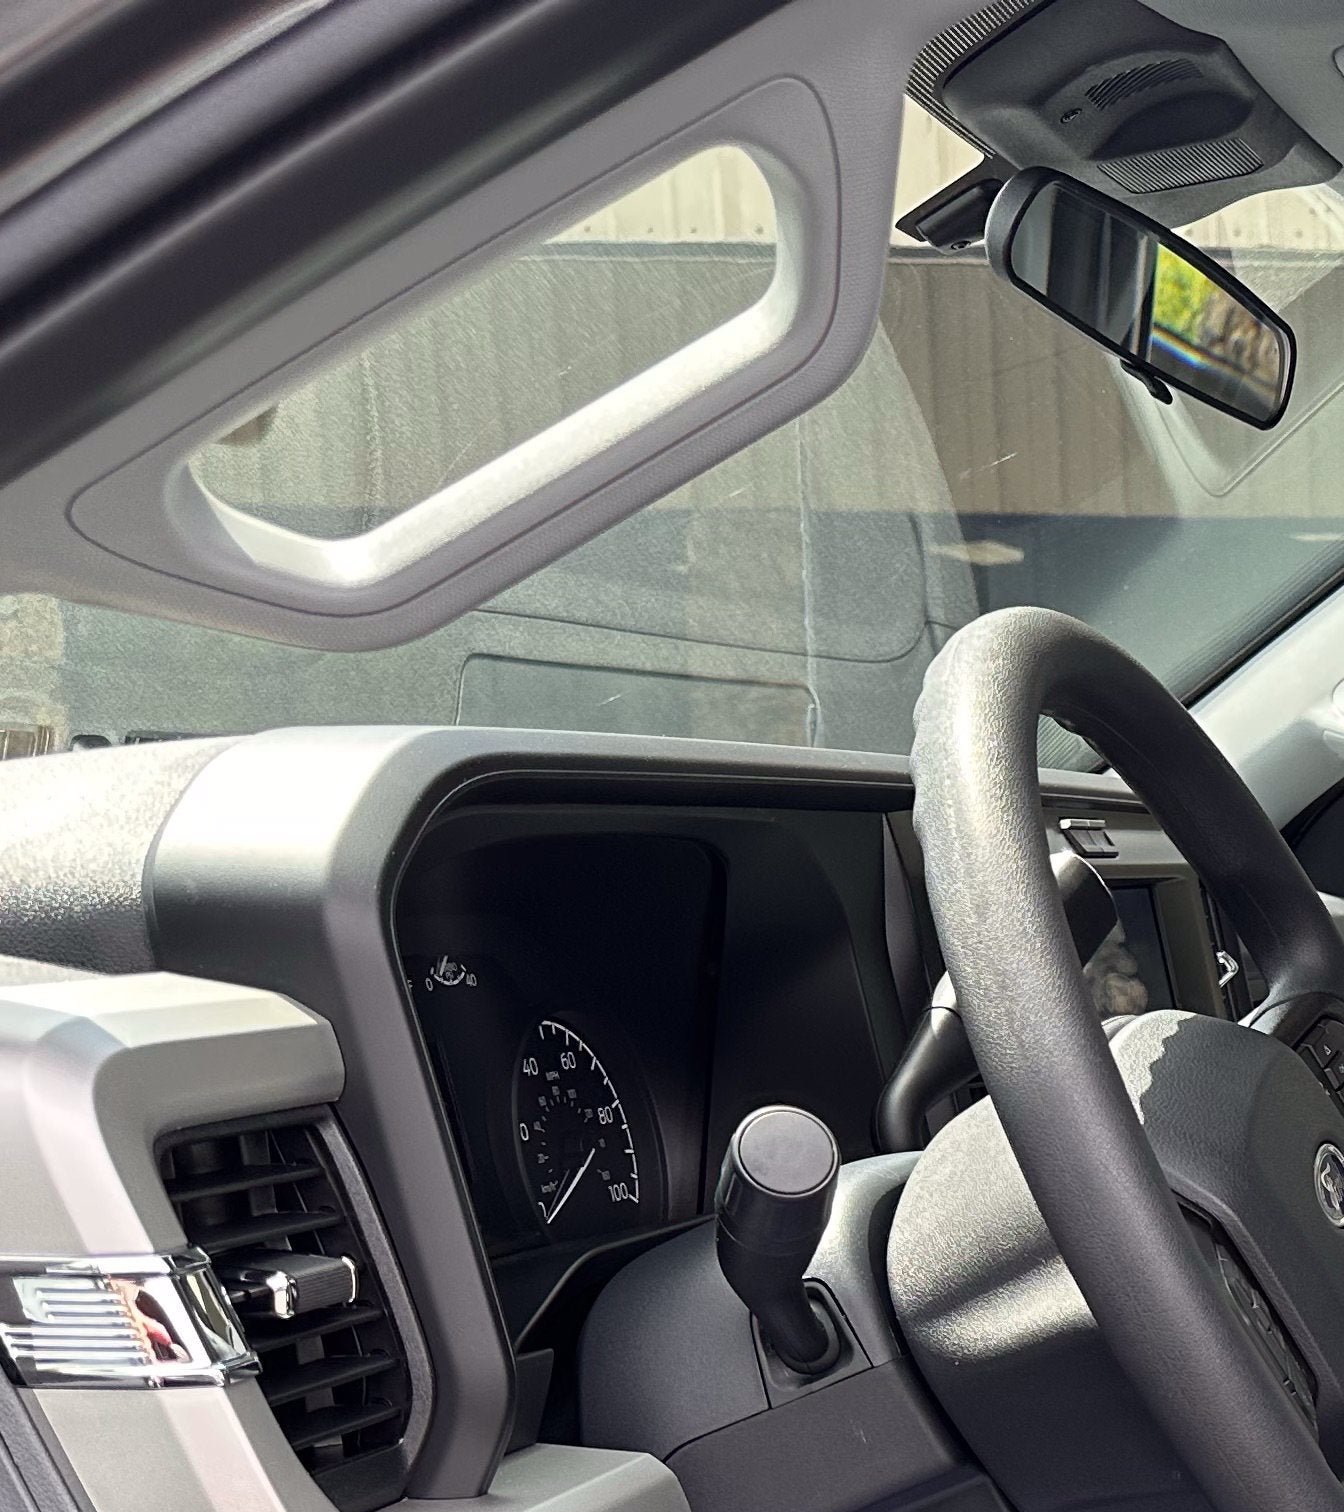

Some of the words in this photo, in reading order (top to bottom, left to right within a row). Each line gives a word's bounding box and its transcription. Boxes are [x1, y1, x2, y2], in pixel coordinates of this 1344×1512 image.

[522, 1057, 539, 1076] 40
[560, 1051, 577, 1070] 60
[597, 1106, 614, 1125] 80
[608, 1182, 629, 1203] 100
